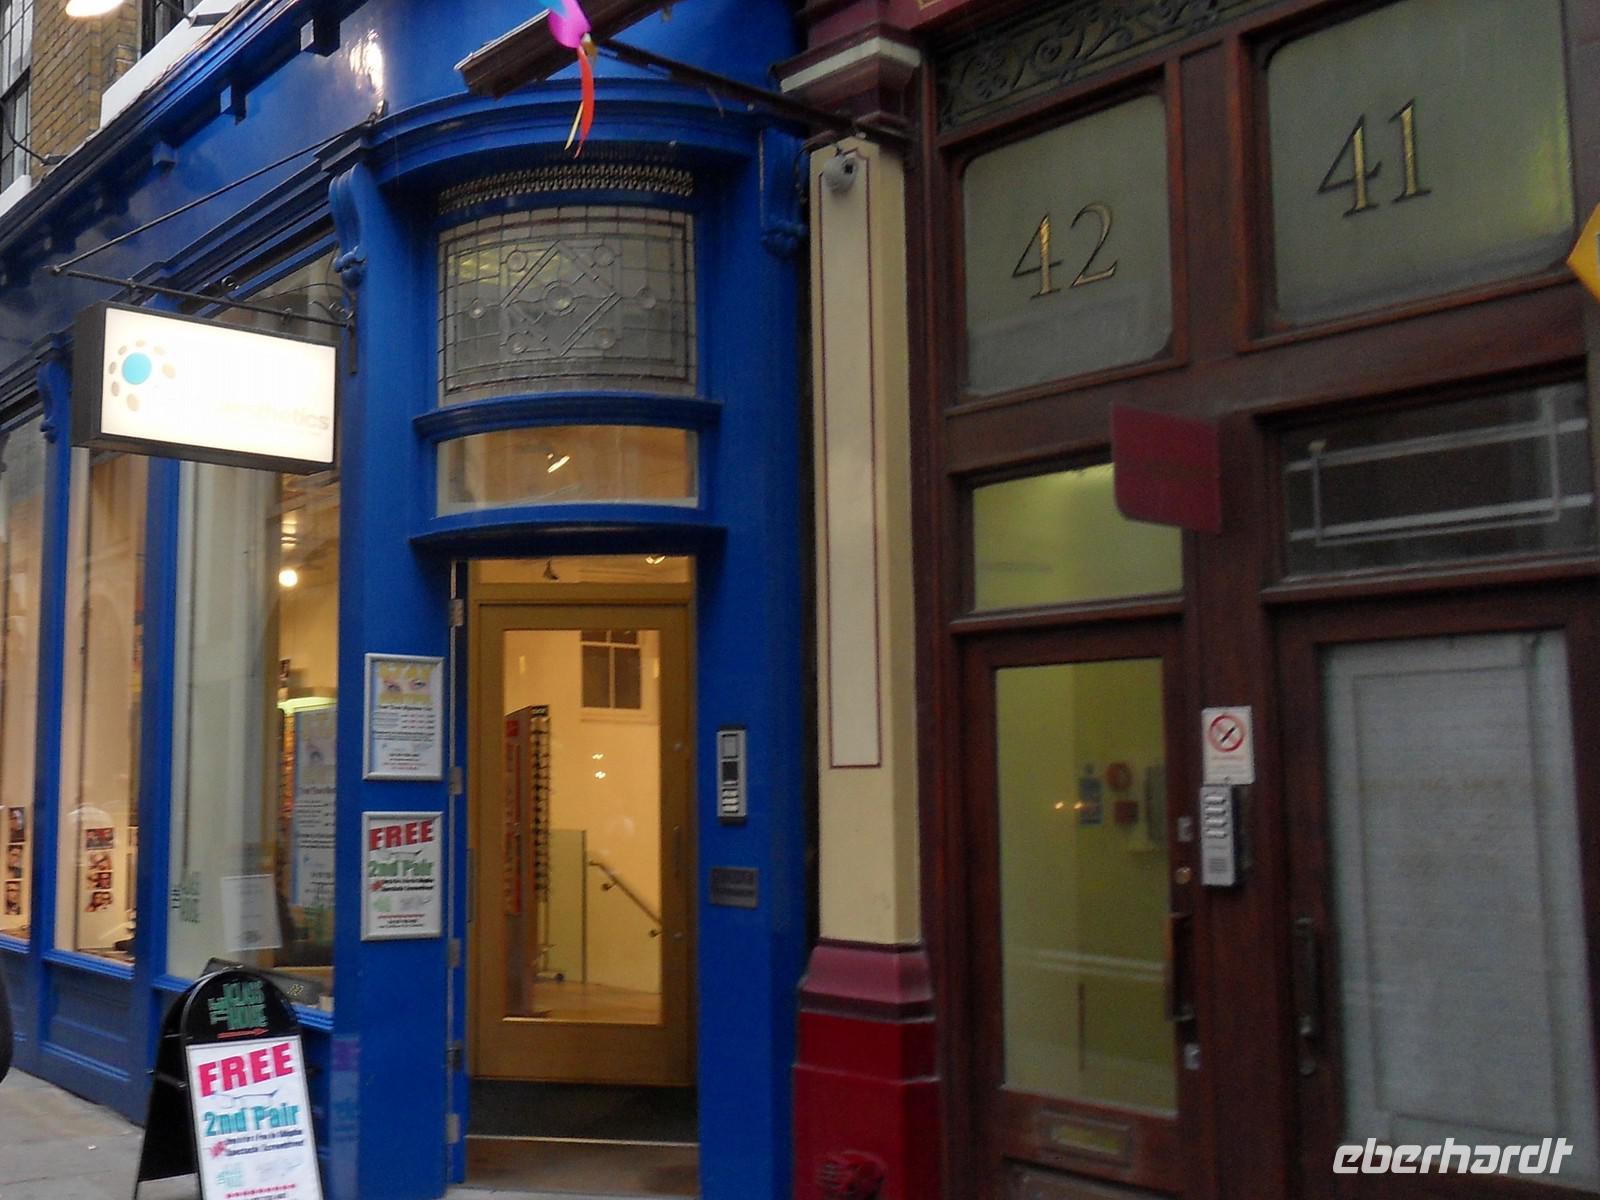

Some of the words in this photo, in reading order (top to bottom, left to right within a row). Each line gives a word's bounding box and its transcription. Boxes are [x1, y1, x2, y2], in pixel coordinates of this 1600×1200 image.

[1317, 97, 1432, 218] 41
[1012, 202, 1118, 299] 42
[368, 820, 434, 851] FREE
[197, 1042, 294, 1098] FREE
[203, 1107, 247, 1137] 2nd
[252, 1102, 299, 1131] Pair
